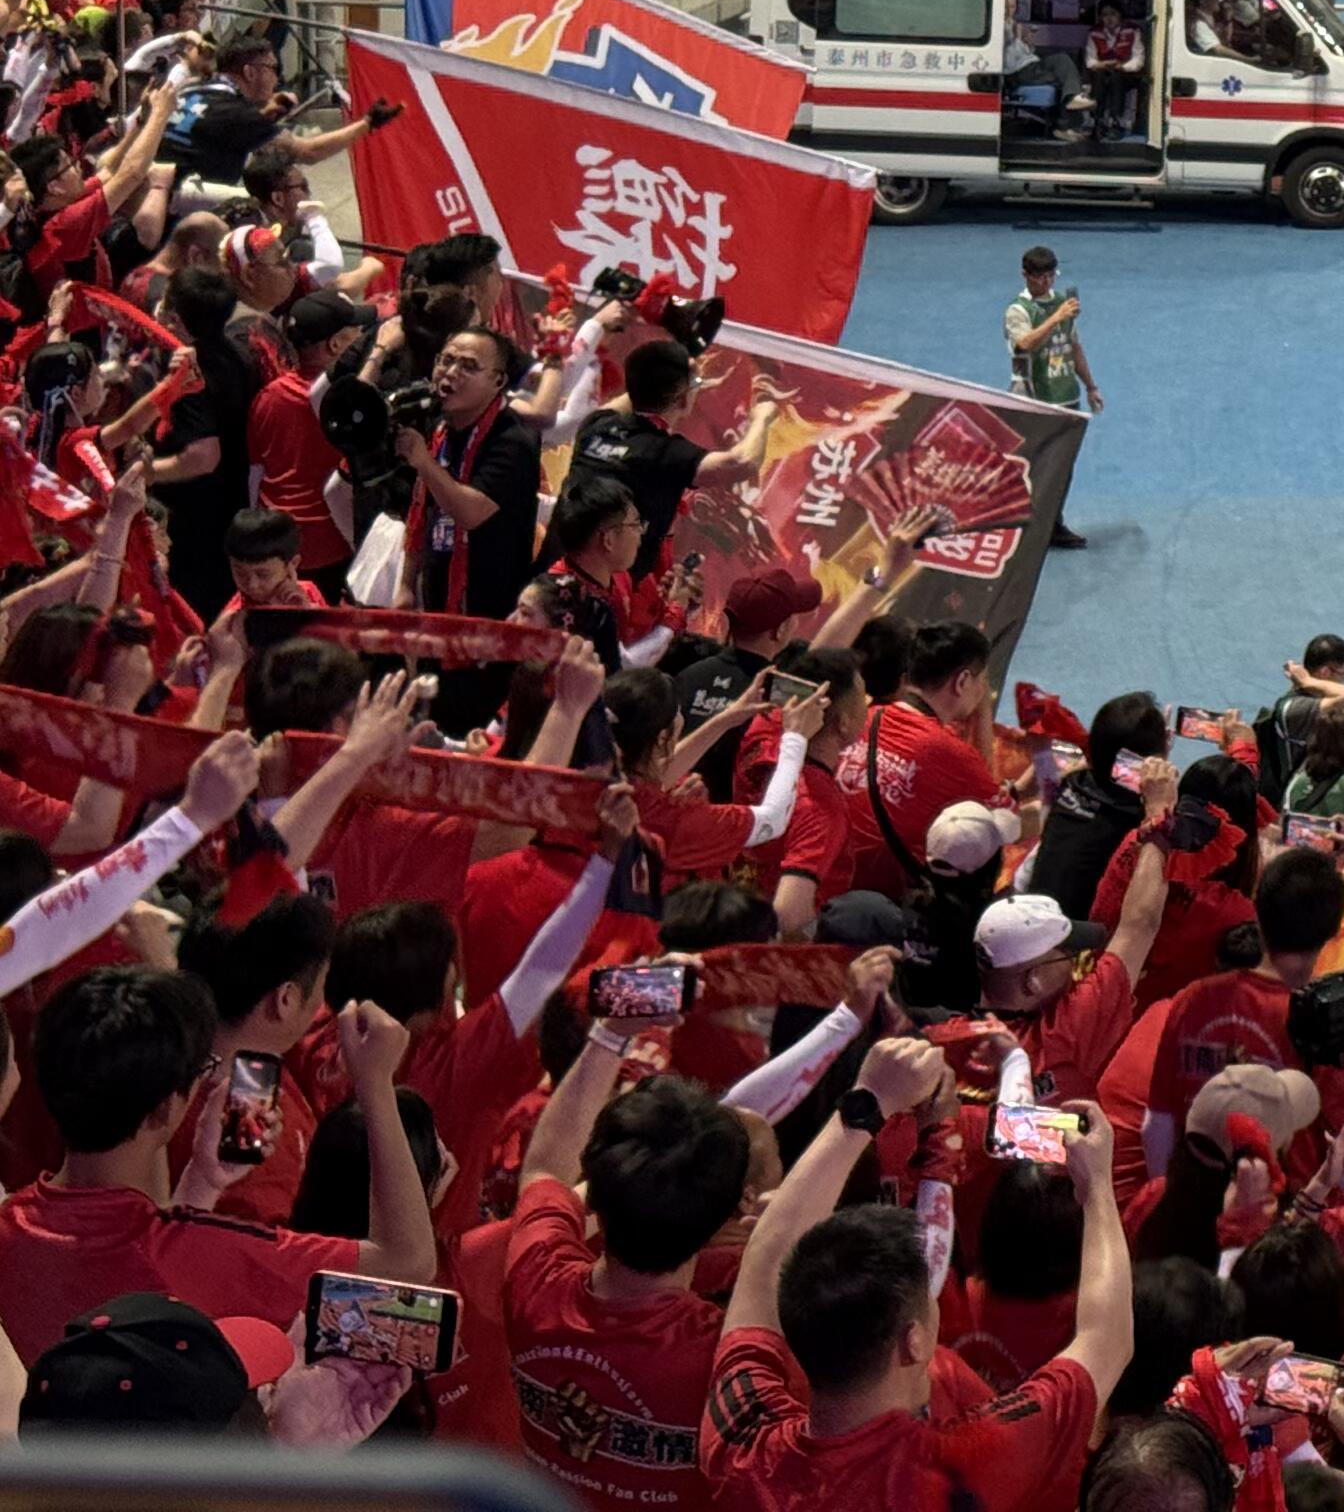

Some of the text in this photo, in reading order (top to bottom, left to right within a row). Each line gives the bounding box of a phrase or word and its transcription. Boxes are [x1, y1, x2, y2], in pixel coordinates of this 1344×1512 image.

[828, 48, 990, 72] 泰州市急救中心
[796, 438, 858, 527] 苏州
[640, 1490, 678, 1502] Club
